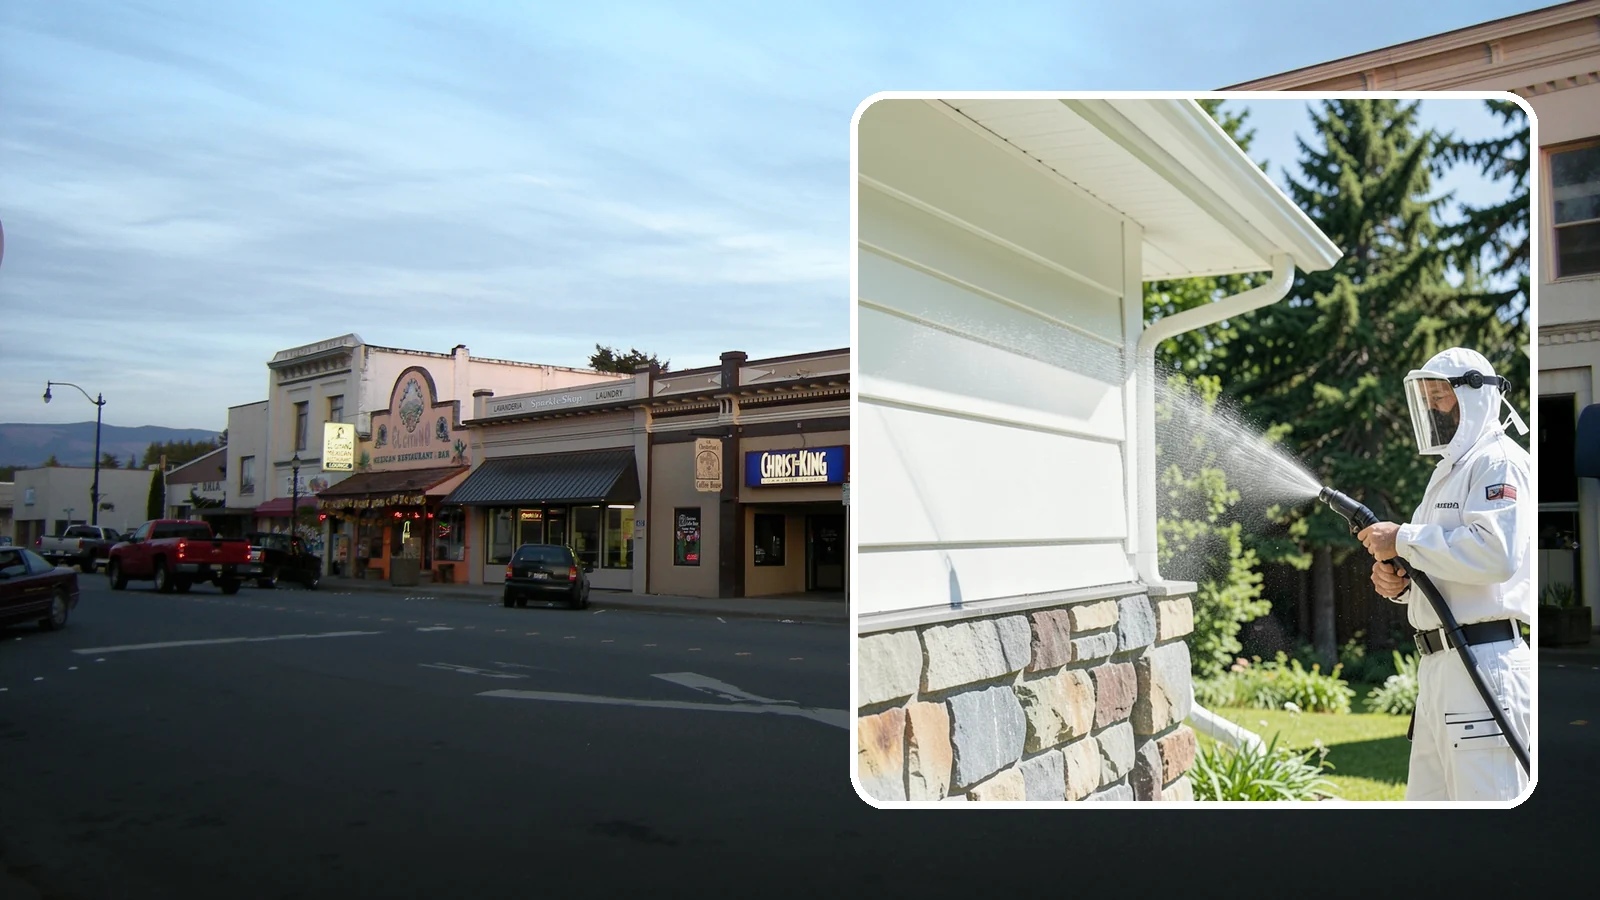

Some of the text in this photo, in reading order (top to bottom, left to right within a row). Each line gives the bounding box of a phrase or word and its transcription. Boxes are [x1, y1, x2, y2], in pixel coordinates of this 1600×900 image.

[595, 389, 623, 400] LAUNDRY
[493, 402, 522, 413] LAVANDERIA
[531, 394, 582, 409] Sparkle Shop
[373, 455, 396, 464] MEXICAN
[397, 451, 433, 462] RESTAURANT
[438, 450, 450, 459] BAR
[760, 449, 828, 478] CHRIST KING
[696, 480, 722, 489] Coffee House
